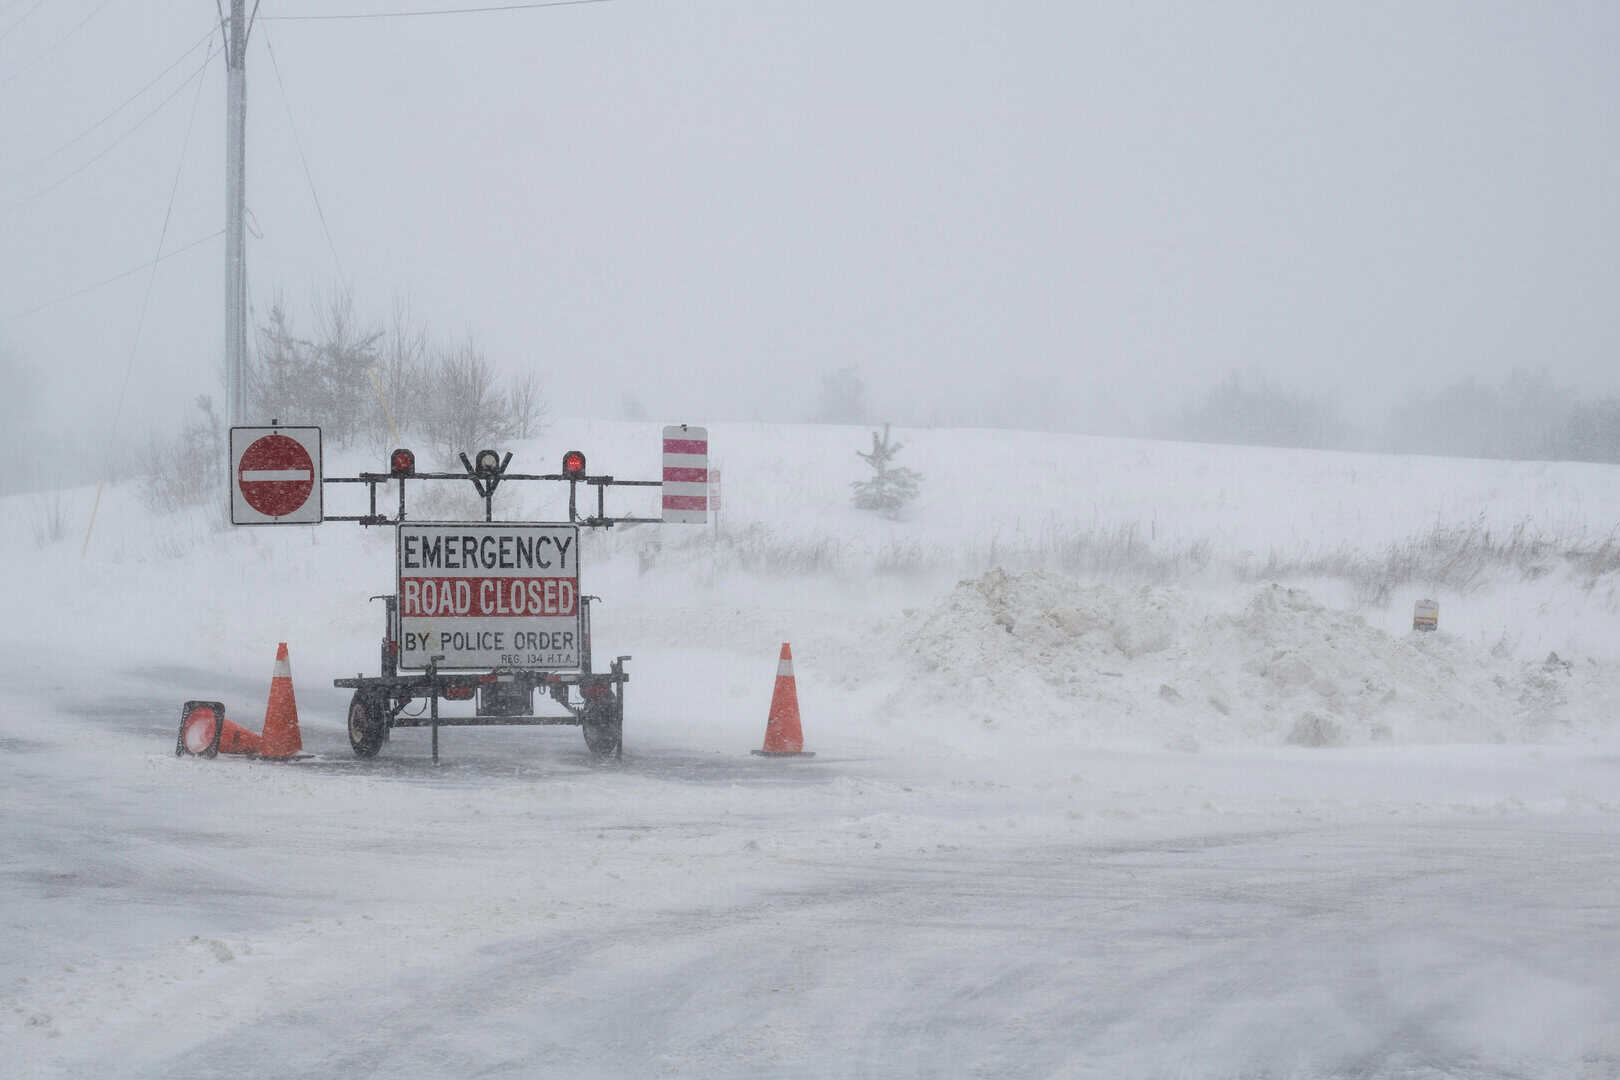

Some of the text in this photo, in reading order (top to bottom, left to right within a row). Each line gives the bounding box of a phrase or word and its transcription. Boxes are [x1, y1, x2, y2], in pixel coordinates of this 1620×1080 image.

[404, 535, 572, 569] EMERGENCY
[404, 580, 574, 615] ROAD CLOSED
[405, 632, 574, 650] BY POLICE ORDER
[527, 654, 543, 664] 134
